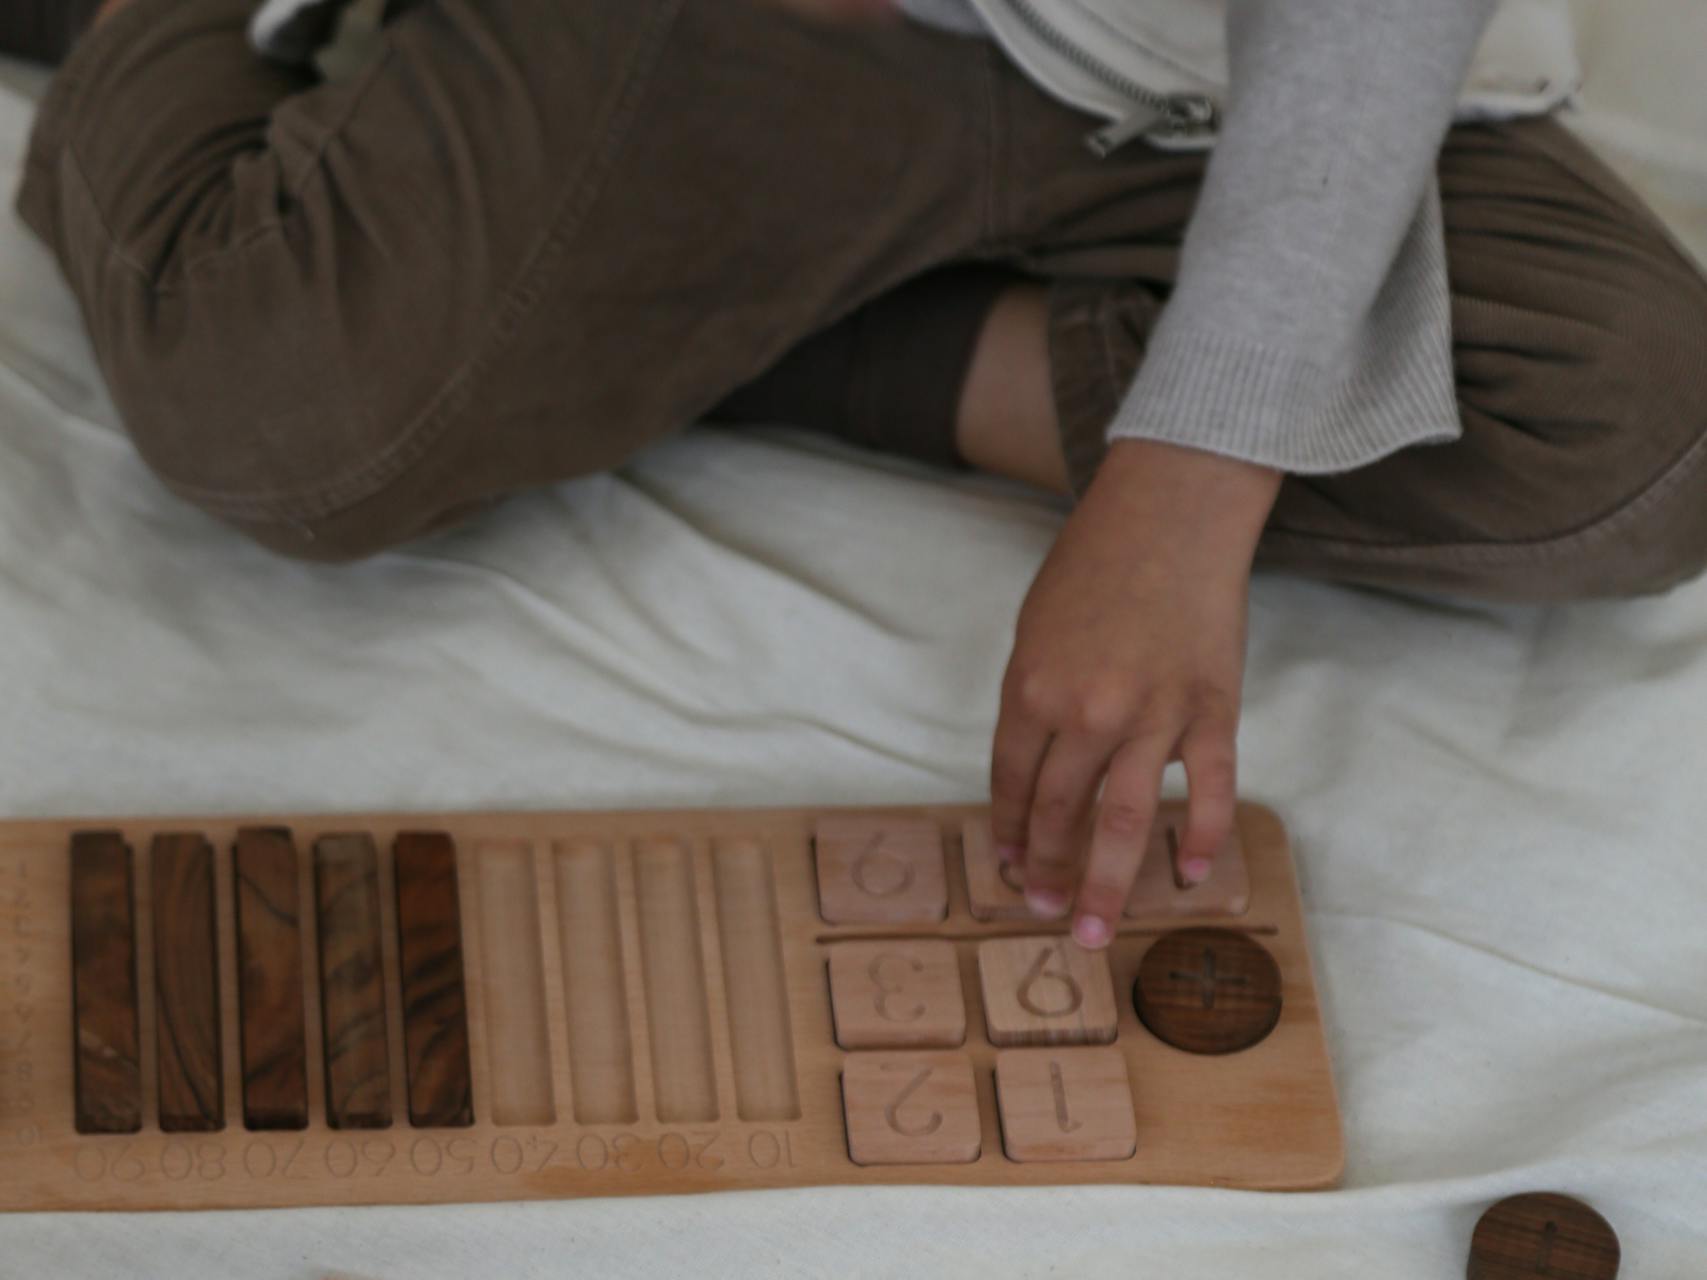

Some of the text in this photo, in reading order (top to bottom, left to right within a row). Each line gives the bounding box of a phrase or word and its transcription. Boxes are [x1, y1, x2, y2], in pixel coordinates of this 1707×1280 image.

[868, 953, 926, 1022] 3
[882, 1061, 943, 1137] 2
[1048, 1060, 1082, 1133] 1
[160, 1140, 228, 1182] 80
[244, 1138, 307, 1180] 70
[324, 1138, 397, 1178] 60
[408, 1135, 480, 1177] 50
[490, 1134, 562, 1175] 40
[575, 1131, 649, 1173] 30
[656, 1130, 725, 1171] 20
[747, 1129, 799, 1170] 10
